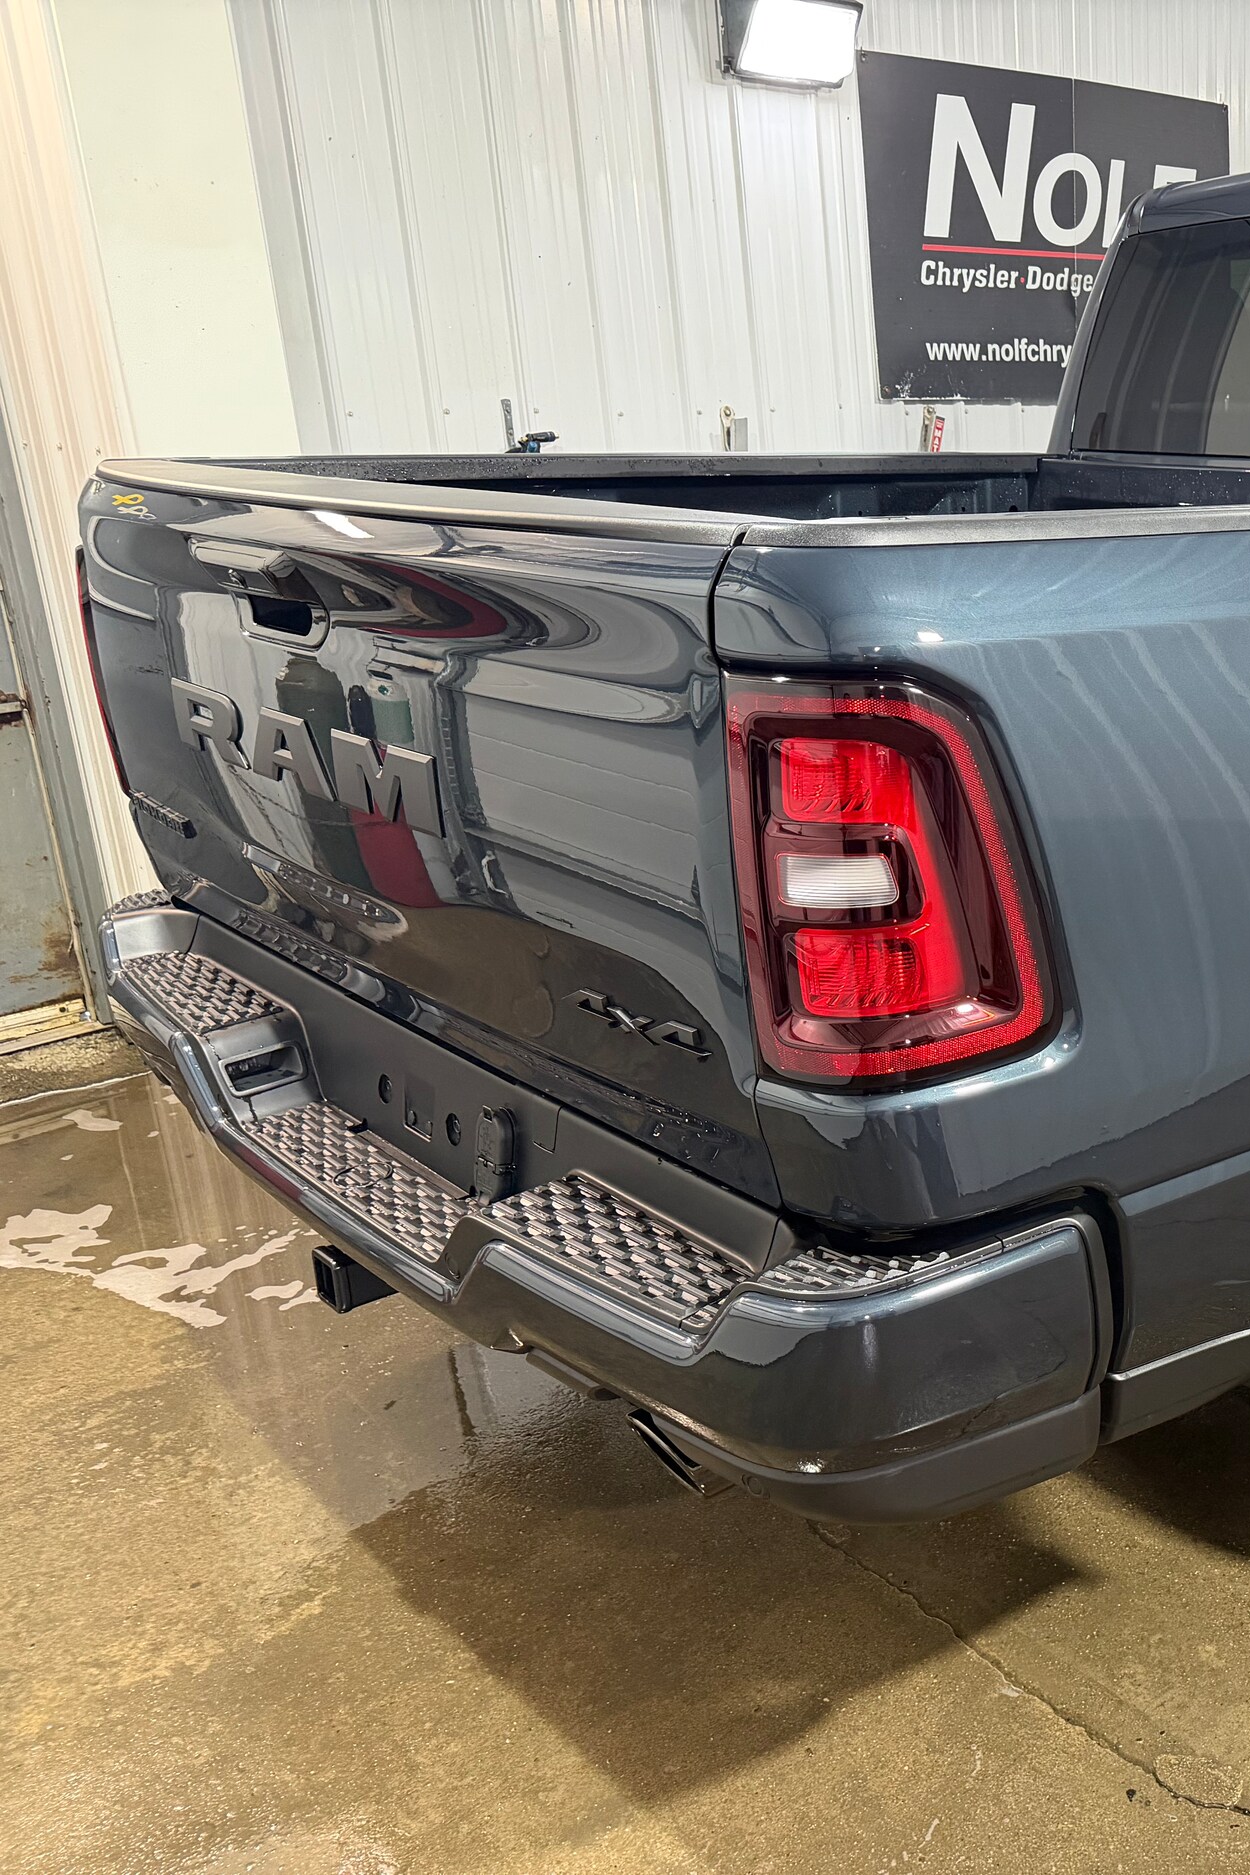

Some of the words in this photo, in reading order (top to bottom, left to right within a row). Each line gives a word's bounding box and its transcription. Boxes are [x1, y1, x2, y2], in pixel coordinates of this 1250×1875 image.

[923, 93, 1197, 247] NOL
[920, 260, 1018, 293] Chrysler
[1025, 265, 1094, 298] Dodge
[170, 677, 446, 838] RAM
